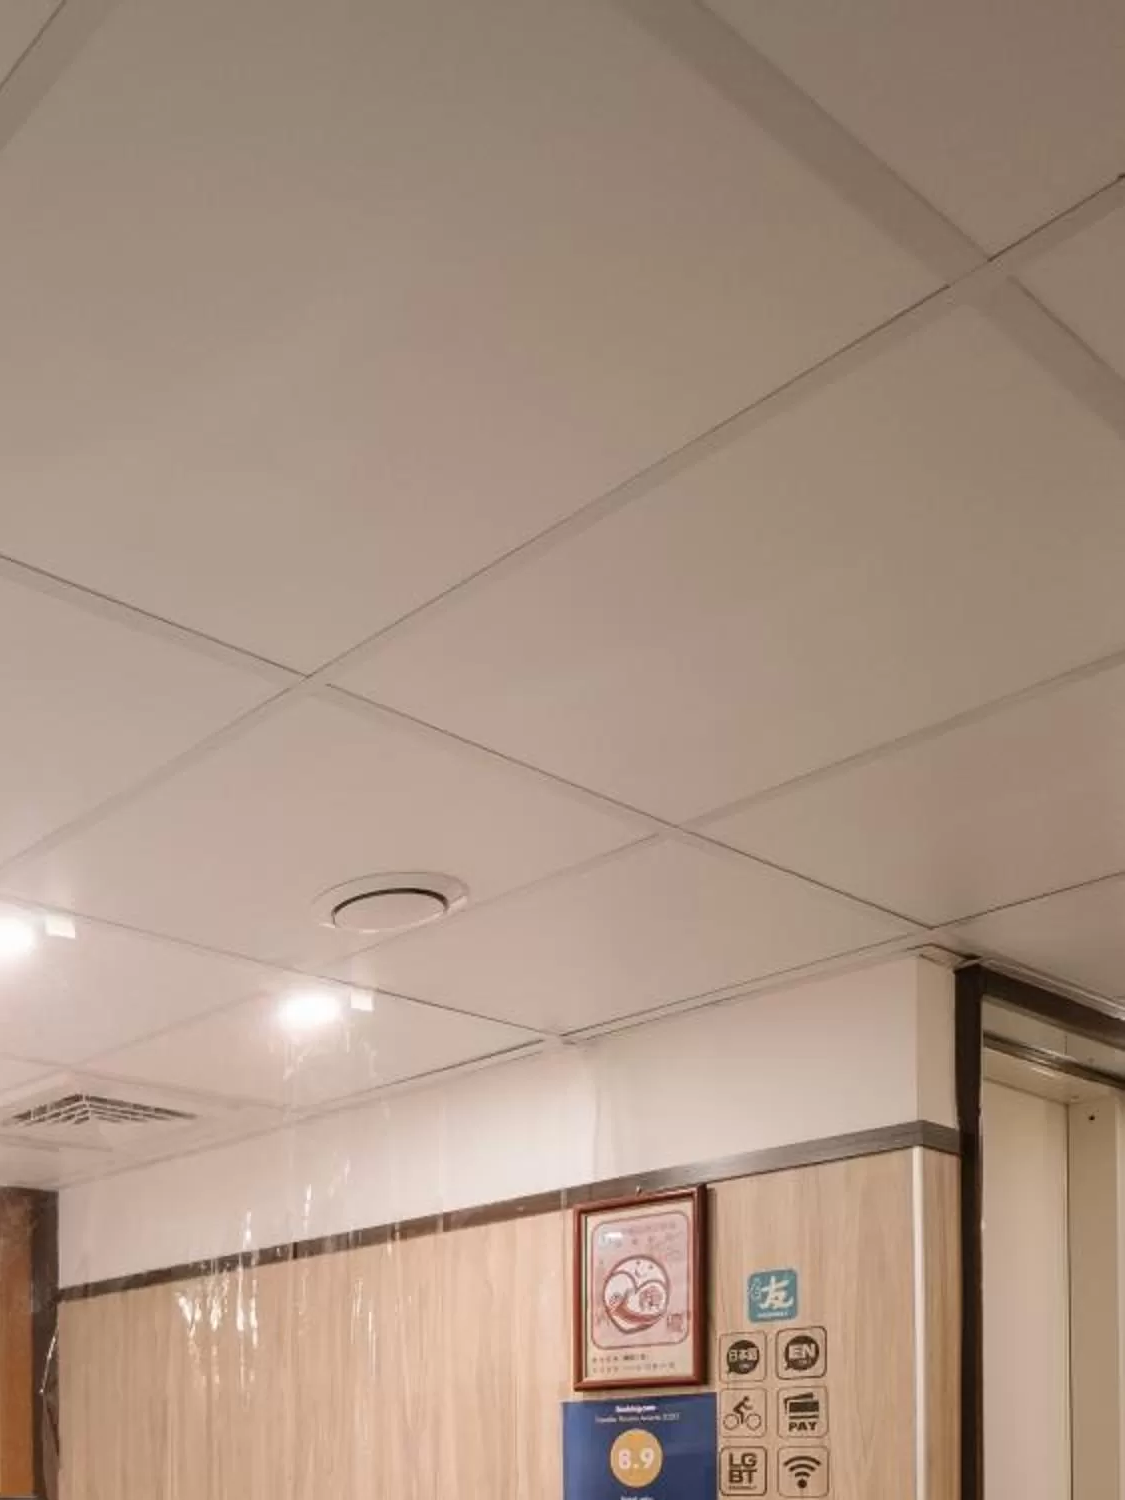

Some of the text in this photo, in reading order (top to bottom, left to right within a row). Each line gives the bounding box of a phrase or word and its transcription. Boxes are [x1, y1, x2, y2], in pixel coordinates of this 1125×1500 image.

[788, 1343, 816, 1360] EN
[788, 1421, 817, 1433] PAY
[618, 1447, 655, 1470] 8.9
[728, 1452, 757, 1468] LG
[728, 1469, 758, 1484] BT
